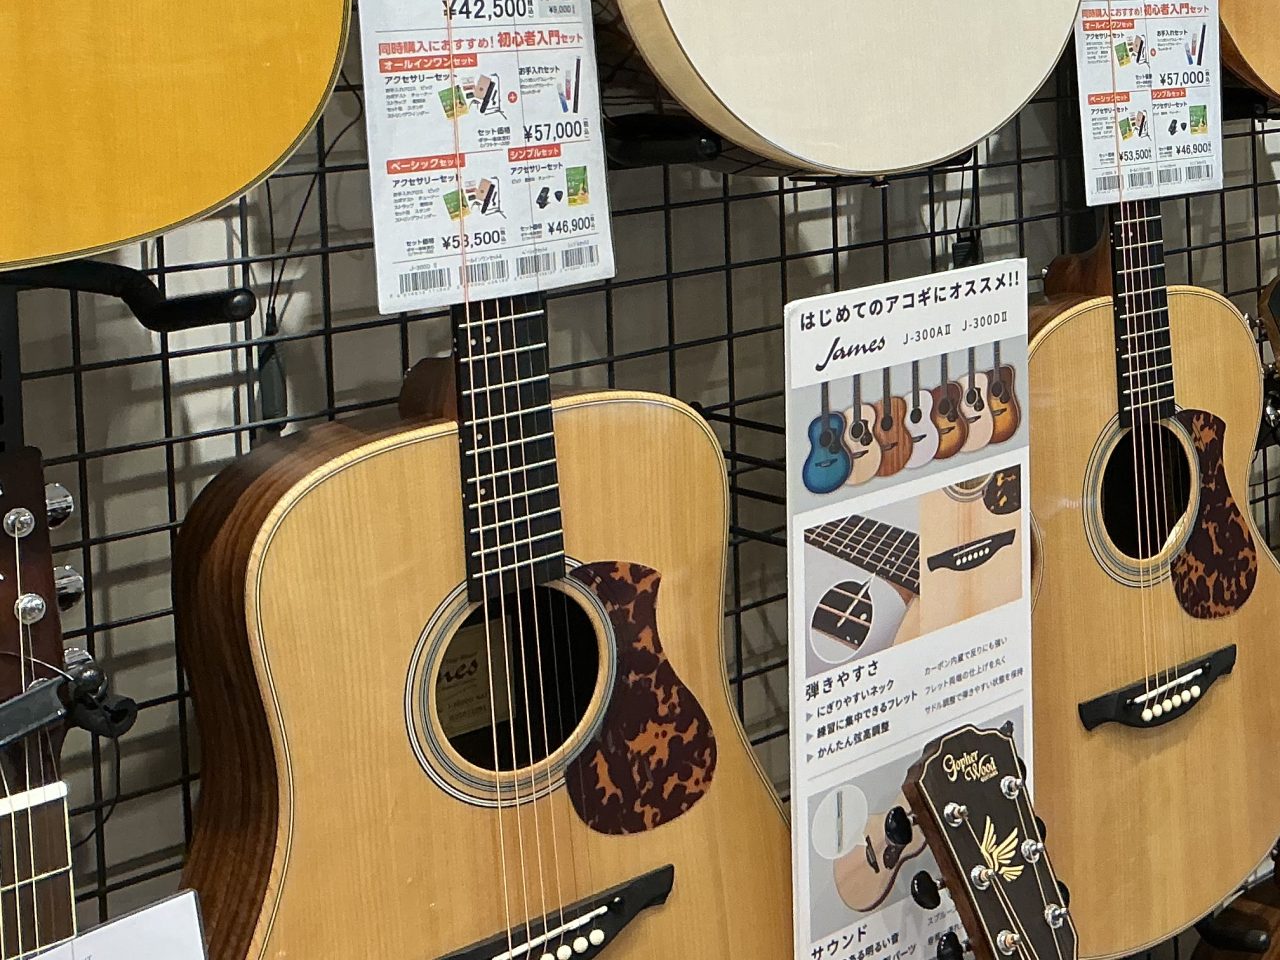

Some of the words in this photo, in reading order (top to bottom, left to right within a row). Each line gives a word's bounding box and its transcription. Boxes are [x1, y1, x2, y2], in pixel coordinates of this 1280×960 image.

[384, 56, 474, 70] オールインワンセット
[385, 72, 457, 84] アクセサリーセット
[519, 65, 560, 75] お手入れセット
[1160, 71, 1204, 86] ¥57,000
[524, 121, 582, 142] ¥57,000
[390, 156, 462, 171] ベーシックセット
[511, 148, 559, 160] シンプルセット
[1119, 149, 1148, 161] ¥53,500
[1176, 143, 1208, 155] ¥46,900
[392, 174, 462, 187] アクセサリーセット
[510, 162, 563, 175] アクセサリーセット
[548, 217, 591, 234] ¥46,900
[800, 270, 1020, 331] はじめてのアコギにオススメ!!
[815, 336, 886, 372] James
[805, 660, 880, 701] 弾きやすさ
[817, 679, 895, 717] にぎりやすいネック
[817, 690, 918, 739] 練習に集中できるフレット
[817, 721, 890, 759] かんたん弦高調整
